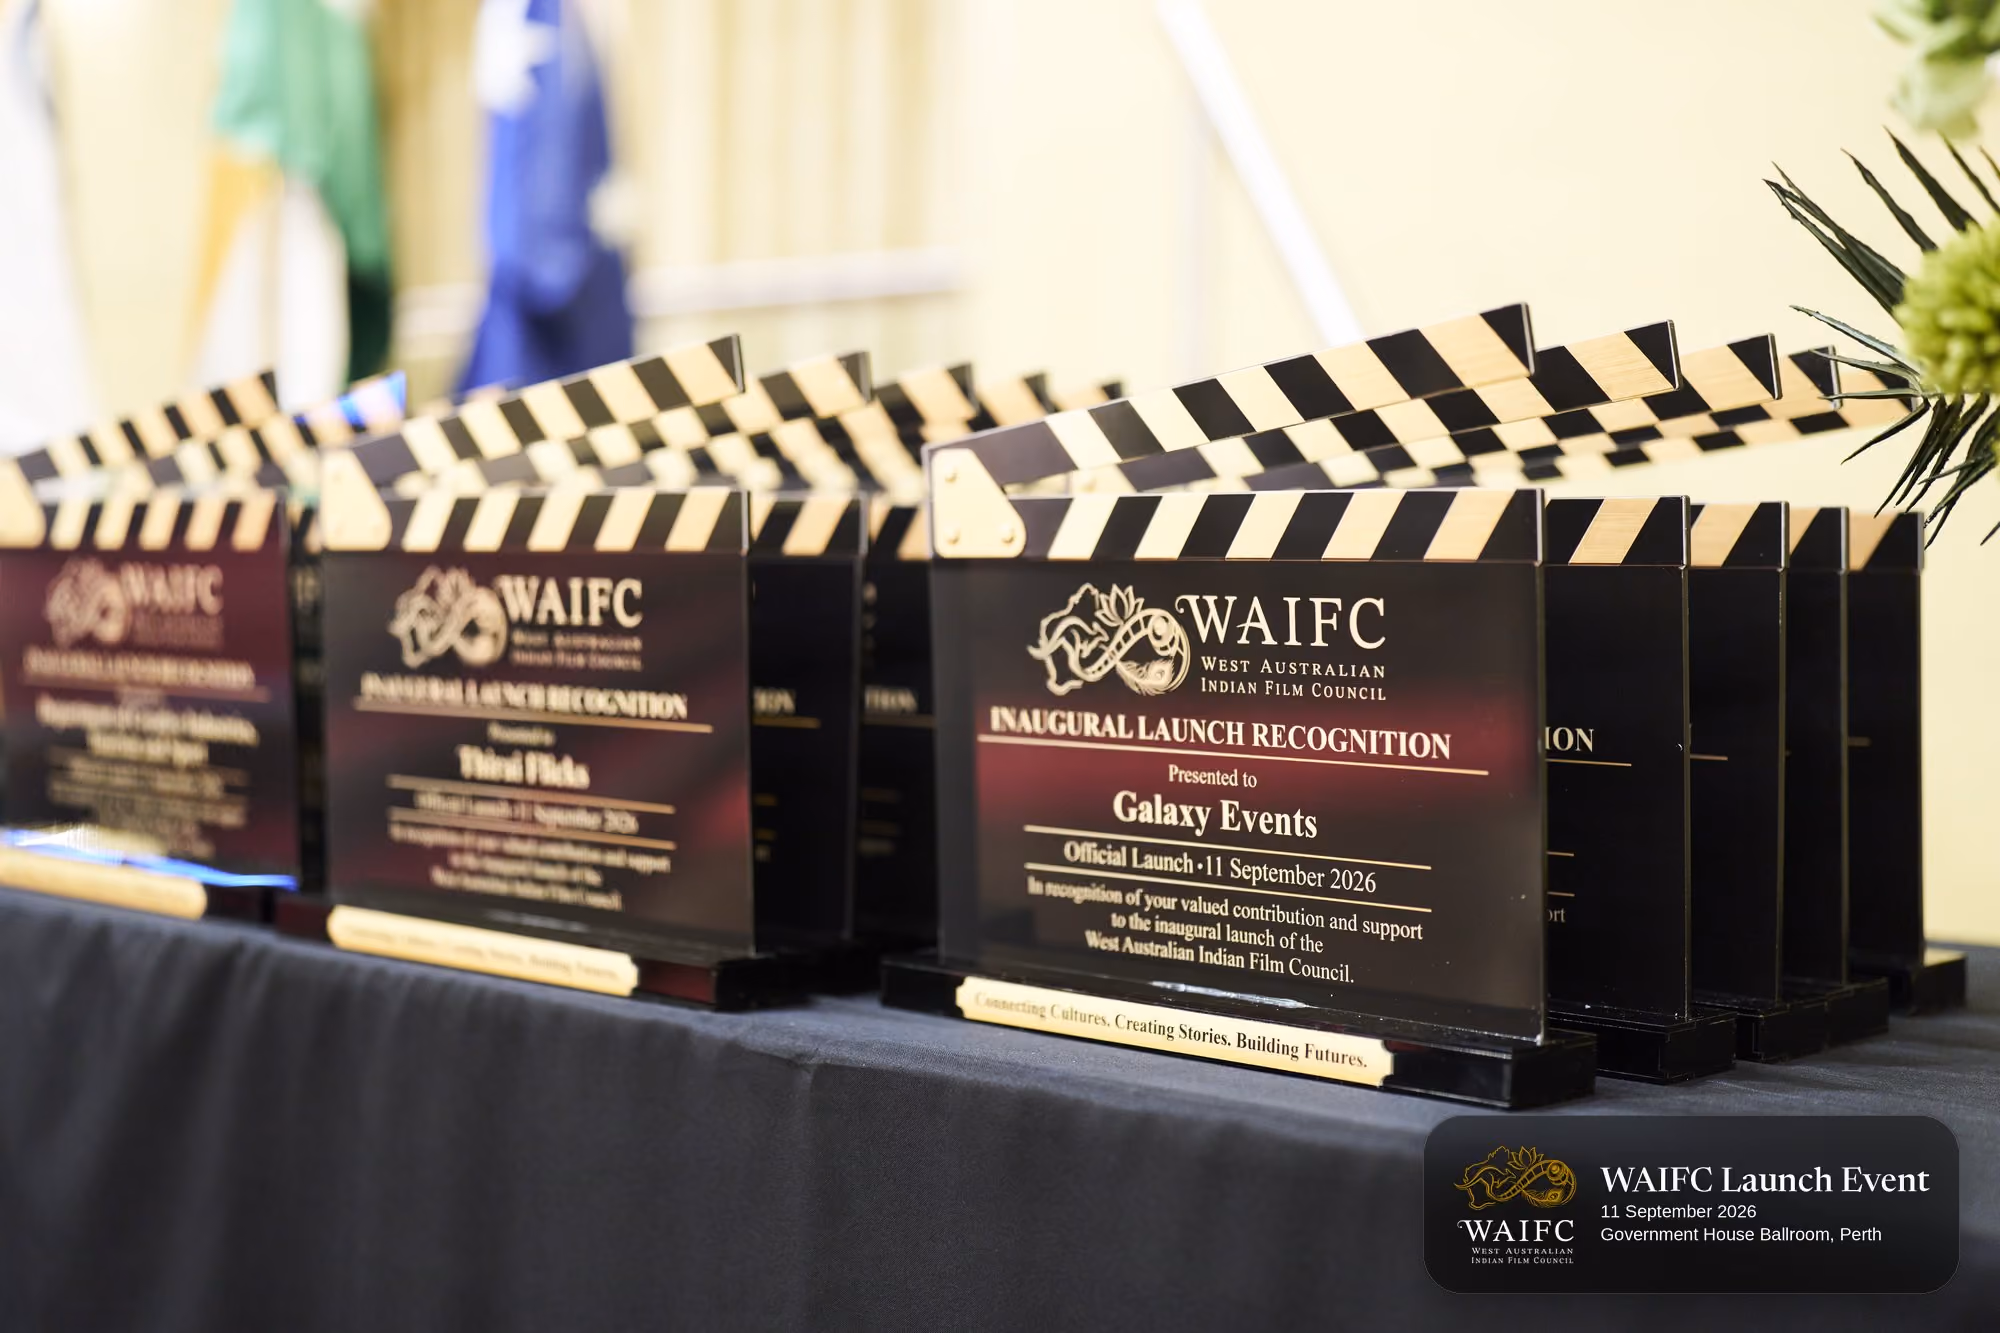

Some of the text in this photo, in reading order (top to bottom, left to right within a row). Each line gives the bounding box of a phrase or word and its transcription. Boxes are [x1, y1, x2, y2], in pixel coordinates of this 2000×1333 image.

[493, 574, 643, 628] WAIFC
[1174, 594, 1386, 650] WAIFC
[1201, 656, 1385, 679] WEST AUSTRALIAN
[1201, 677, 1386, 701] INDIAN FILM COUNCIL
[990, 706, 1452, 760] INAUGURAL LAUNCH RECOGNITION
[1168, 764, 1258, 788] Presented to
[1113, 790, 1318, 838] Galaxy Events
[1063, 841, 1377, 893] Official Launch 11 September 2026
[1045, 883, 1123, 905] recognition
[1125, 888, 1142, 906] of
[1143, 894, 1178, 912] your
[1181, 896, 1229, 917] valued
[1232, 904, 1325, 928] contribution
[1329, 914, 1358, 932] and
[1362, 919, 1424, 942] support
[1111, 912, 1324, 953] to the inaugural launch of the
[1084, 929, 1354, 983] West Australian Indian Film Council.
[974, 991, 1368, 1068] Connecting Cultures. Creating Stories. Building Futures.
